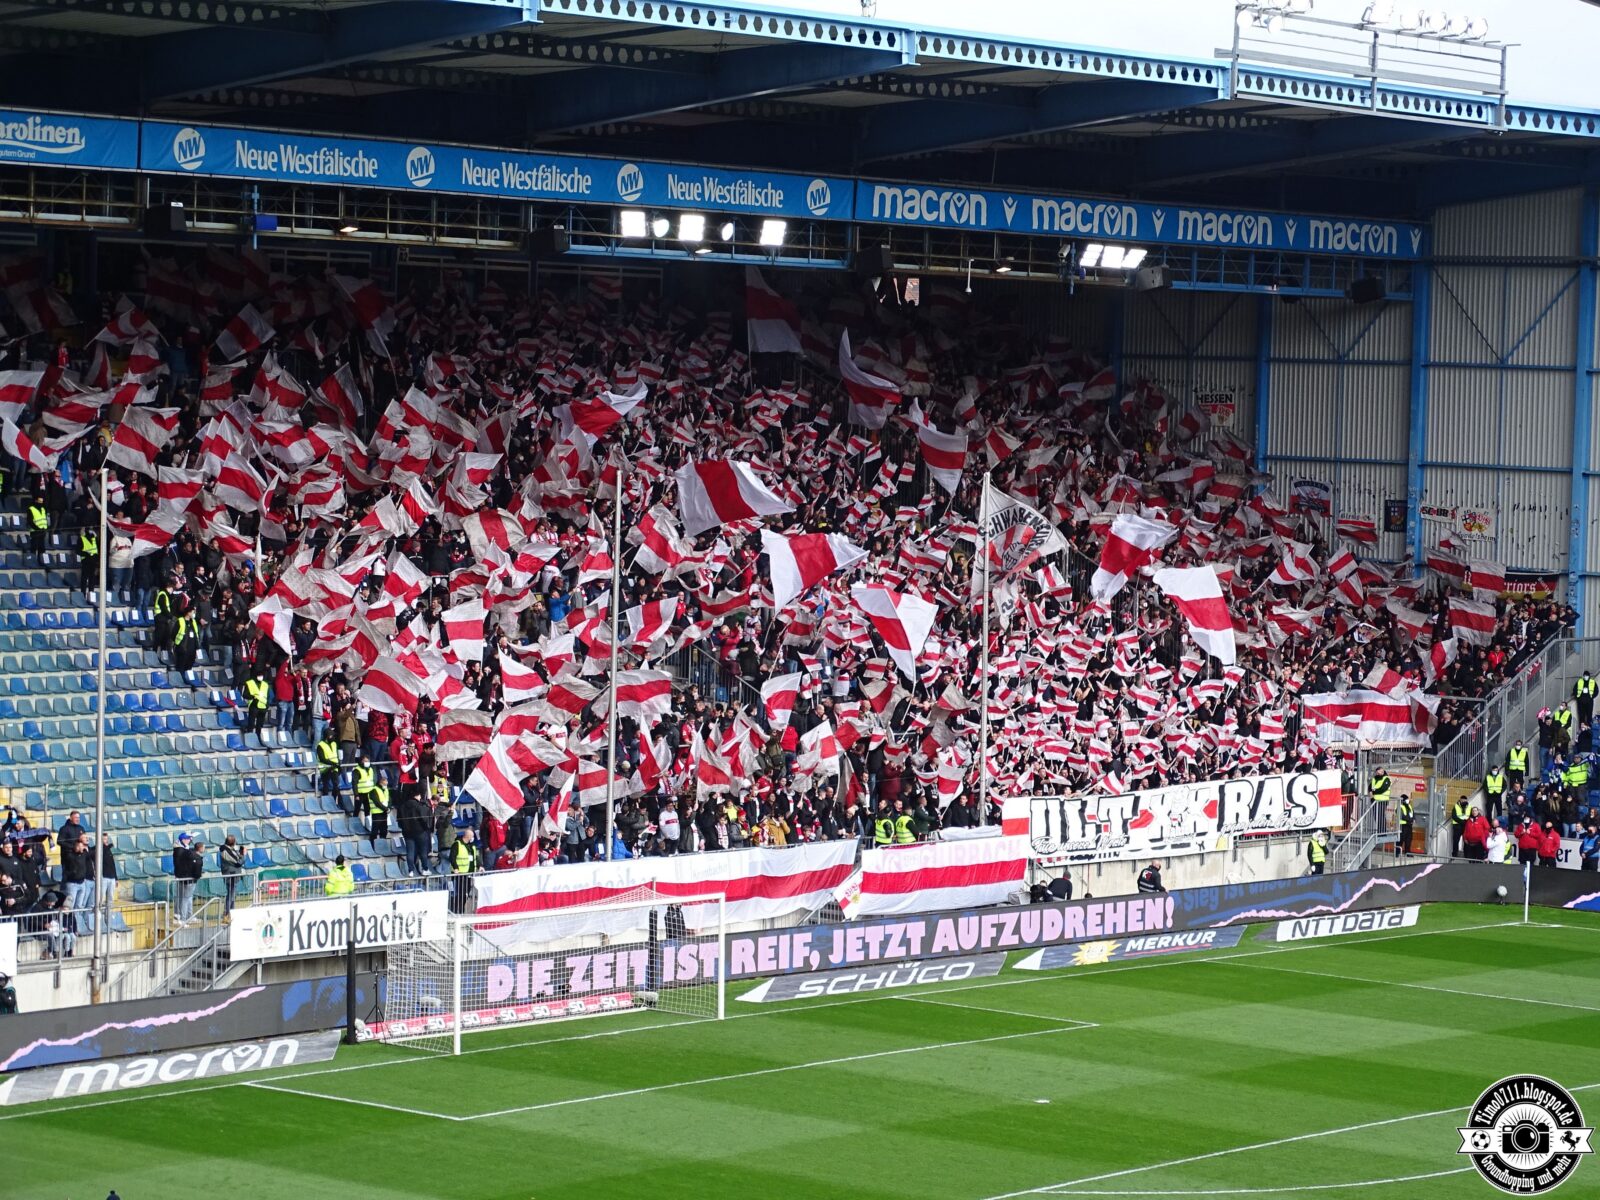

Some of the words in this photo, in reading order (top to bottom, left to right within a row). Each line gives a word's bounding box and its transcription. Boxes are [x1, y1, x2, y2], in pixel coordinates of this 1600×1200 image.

[235, 140, 277, 172] Neue
[280, 145, 378, 179] Westfälische
[462, 158, 500, 187] Neue
[502, 162, 592, 194] Westfälische
[668, 174, 701, 200] Neue
[703, 176, 783, 207] Westfälische
[872, 185, 987, 226] macron
[1032, 198, 1138, 237] macron
[1178, 210, 1272, 246] macron
[1309, 220, 1397, 254] macron
[1197, 393, 1233, 404] HESSEN
[288, 900, 428, 951] Krombacher
[1125, 930, 1217, 952] MERKUR
[487, 960, 553, 1003] DIE
[565, 950, 649, 993] ZEIT
[662, 942, 720, 982] IST
[731, 934, 820, 972] REIF,
[829, 920, 925, 964] JETZT
[932, 896, 1175, 953] AUFZUDREHEN!
[794, 961, 976, 998] SCHÜCO
[53, 1038, 300, 1098] macron
